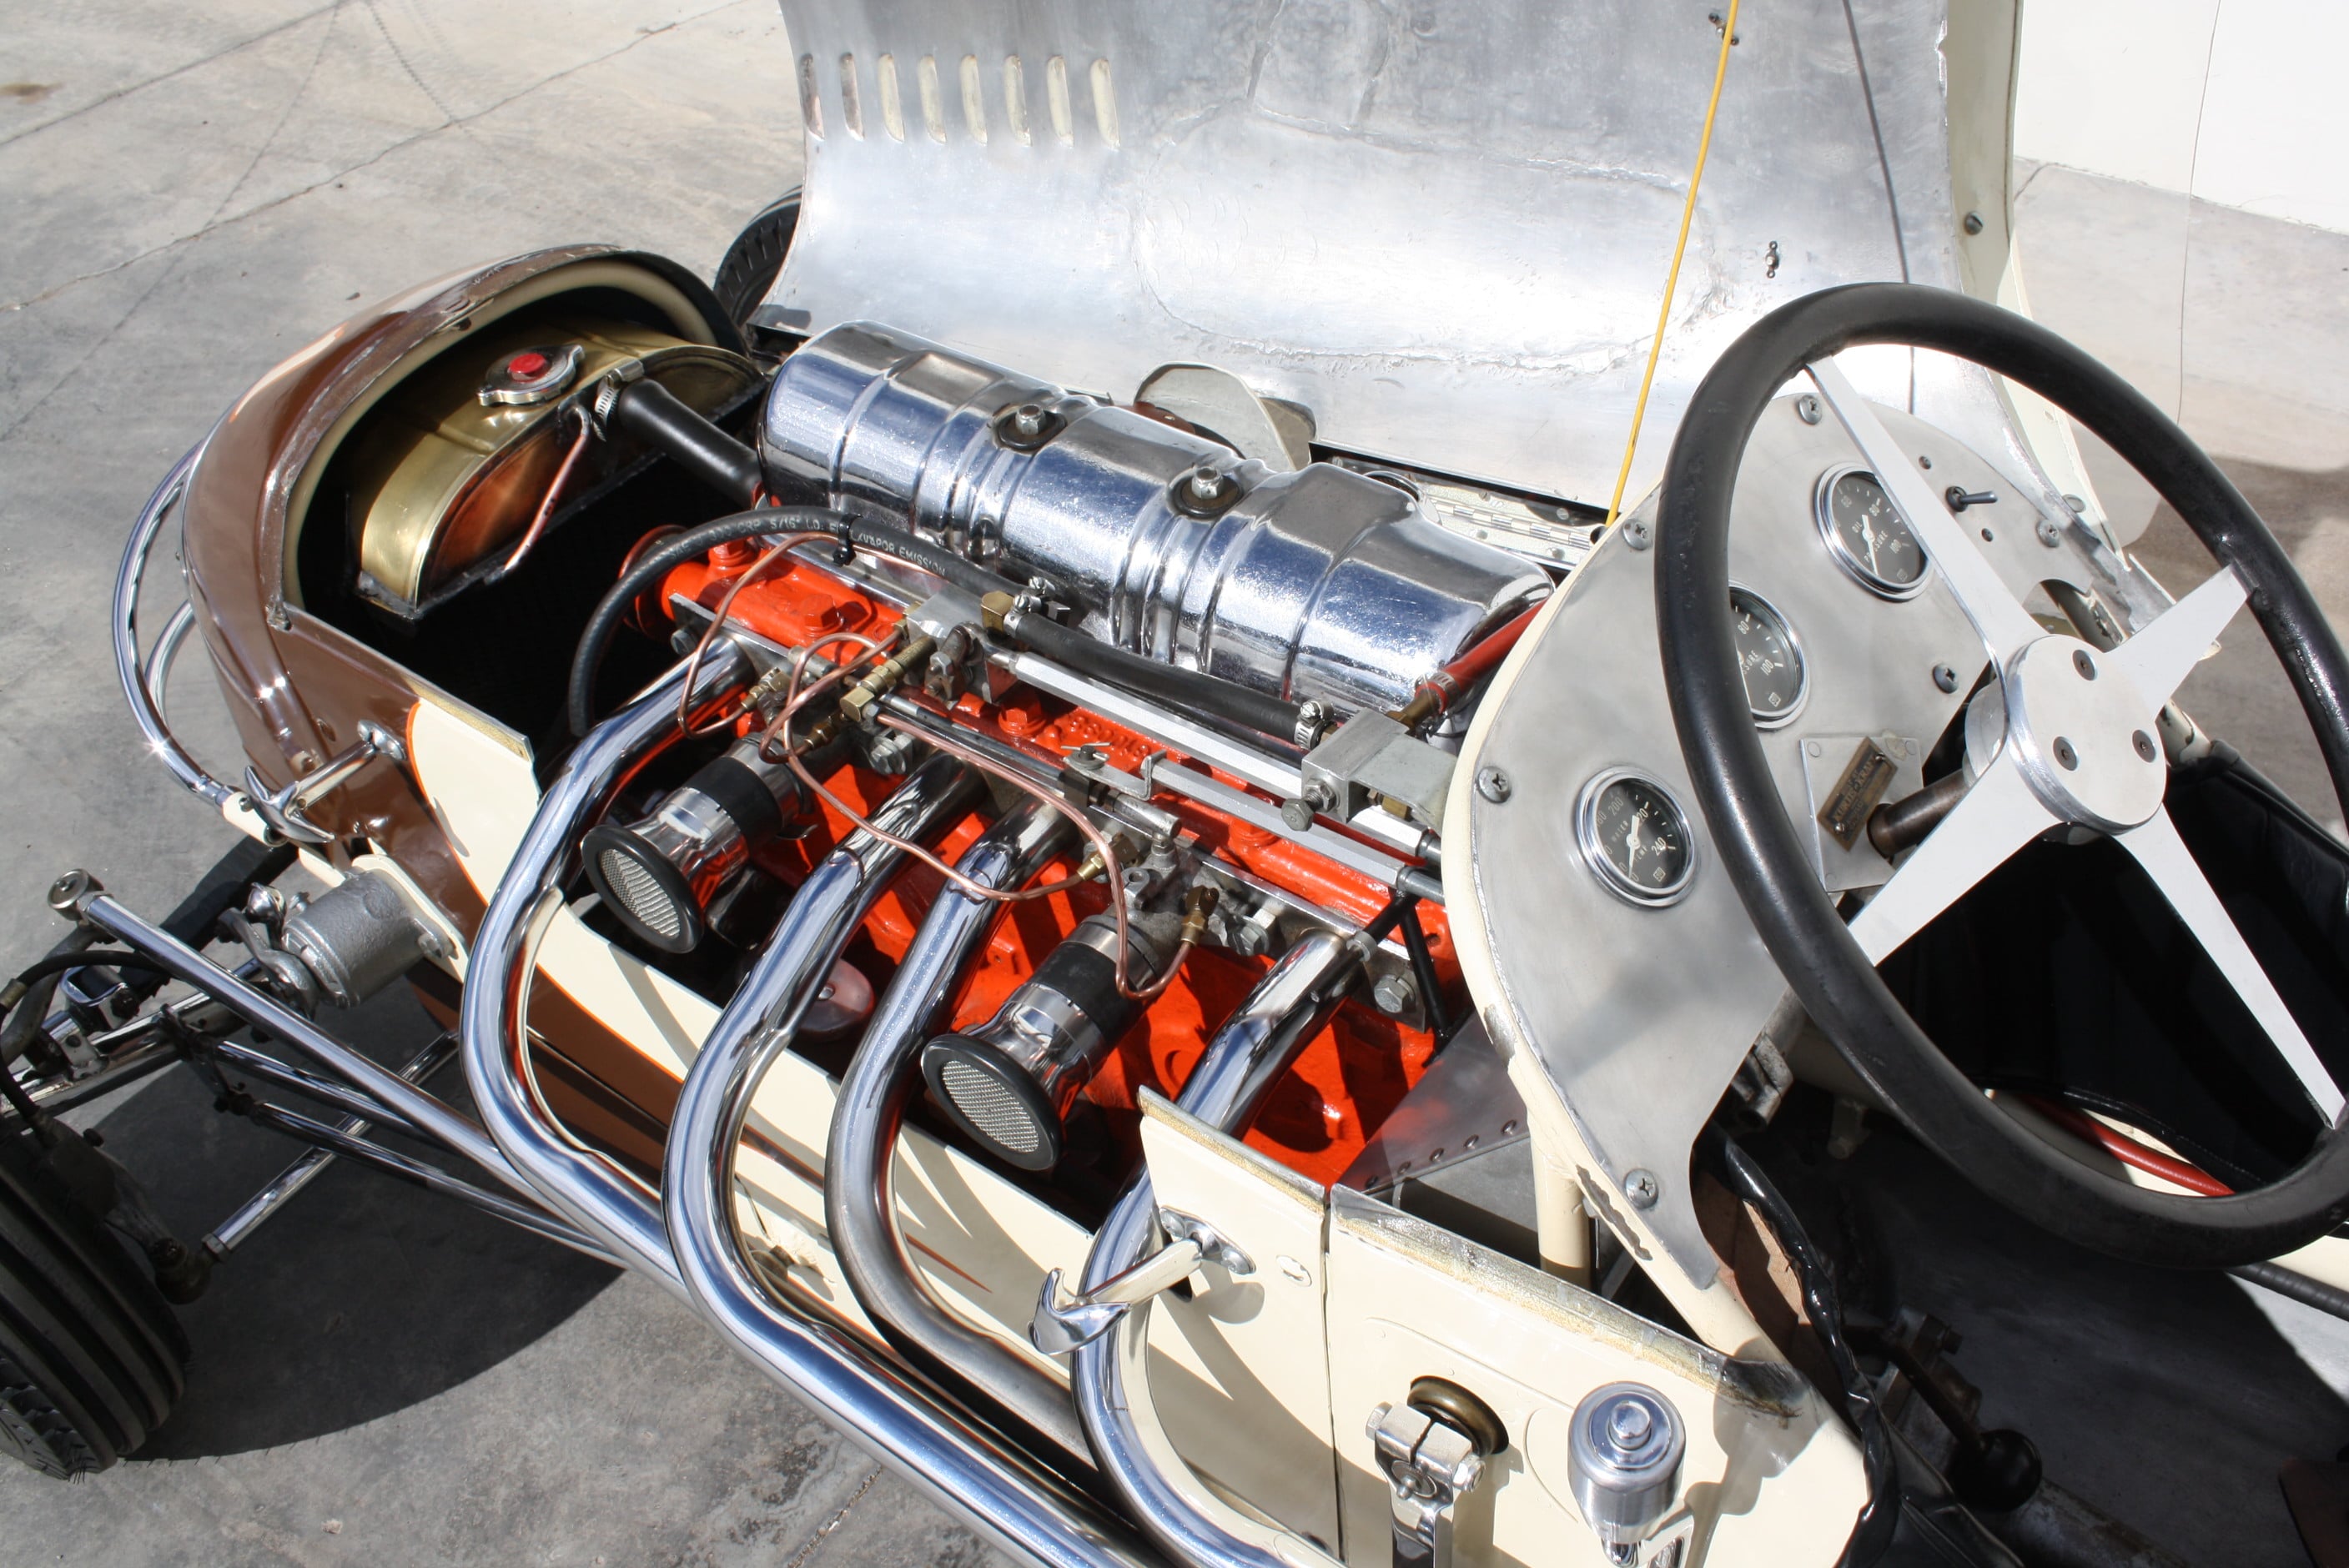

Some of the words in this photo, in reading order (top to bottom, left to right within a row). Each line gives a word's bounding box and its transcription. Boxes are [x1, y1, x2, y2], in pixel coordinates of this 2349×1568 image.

[1869, 504, 1880, 516] 80
[1852, 521, 1862, 533] OIL
[1889, 540, 1902, 554] 100
[899, 546, 945, 575] EMISSION
[1738, 621, 1750, 634] 80
[1760, 659, 1774, 676] 100
[1608, 797, 1623, 816] 200
[1652, 837, 1667, 856] 240
